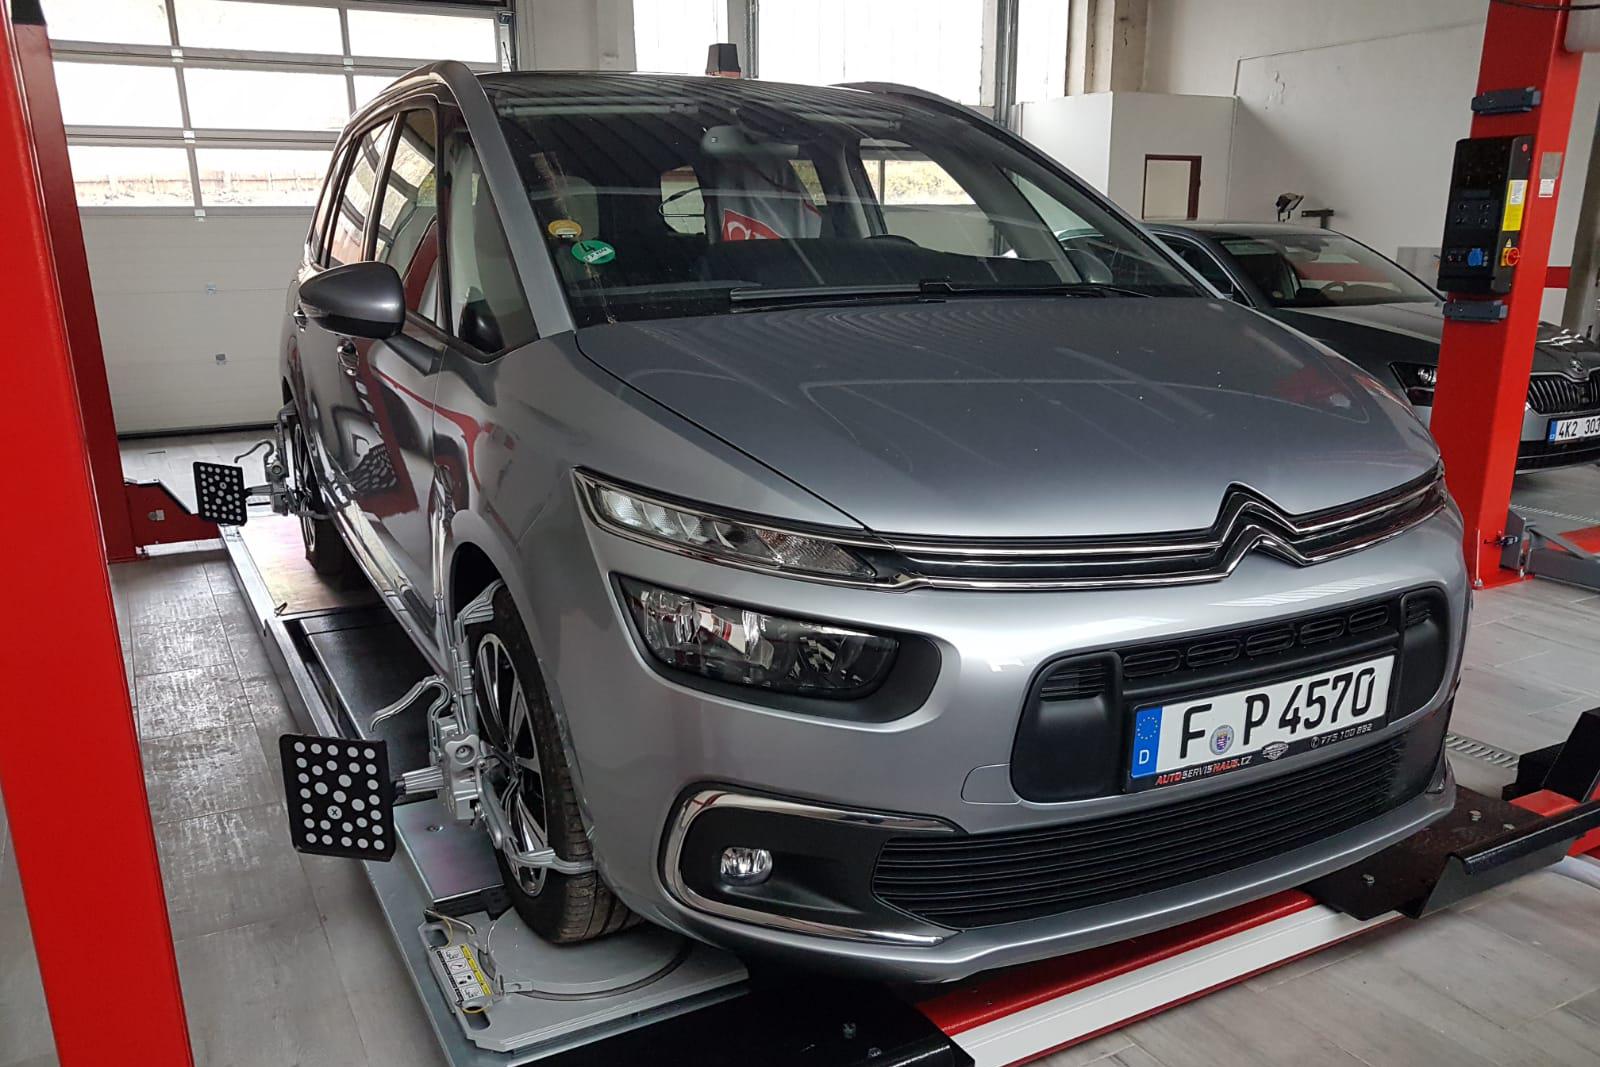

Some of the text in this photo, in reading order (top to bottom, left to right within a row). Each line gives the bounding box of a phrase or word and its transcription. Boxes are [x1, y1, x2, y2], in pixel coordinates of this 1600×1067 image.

[1559, 417, 1600, 438] 4K2 303
[1179, 667, 1376, 759] F P 4570
[1321, 732, 1339, 745] 775
[1340, 728, 1356, 740] 100
[1138, 749, 1150, 765] D
